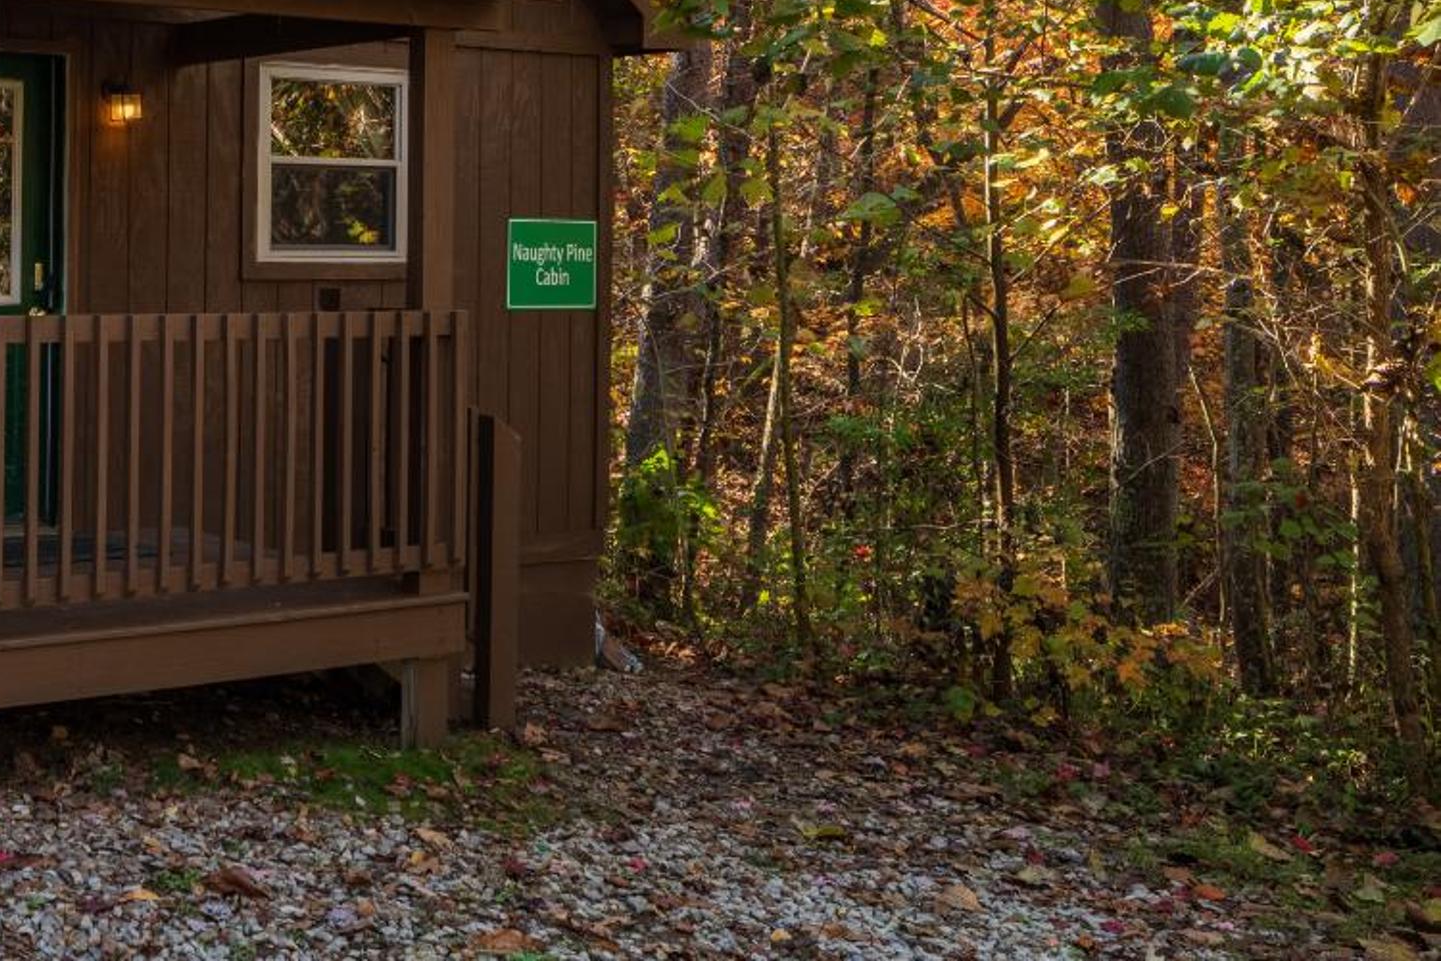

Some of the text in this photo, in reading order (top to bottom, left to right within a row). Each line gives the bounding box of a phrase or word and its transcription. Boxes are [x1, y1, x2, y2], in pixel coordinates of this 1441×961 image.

[512, 243, 593, 266] Naughty Pine
[535, 267, 570, 286] Cabin
